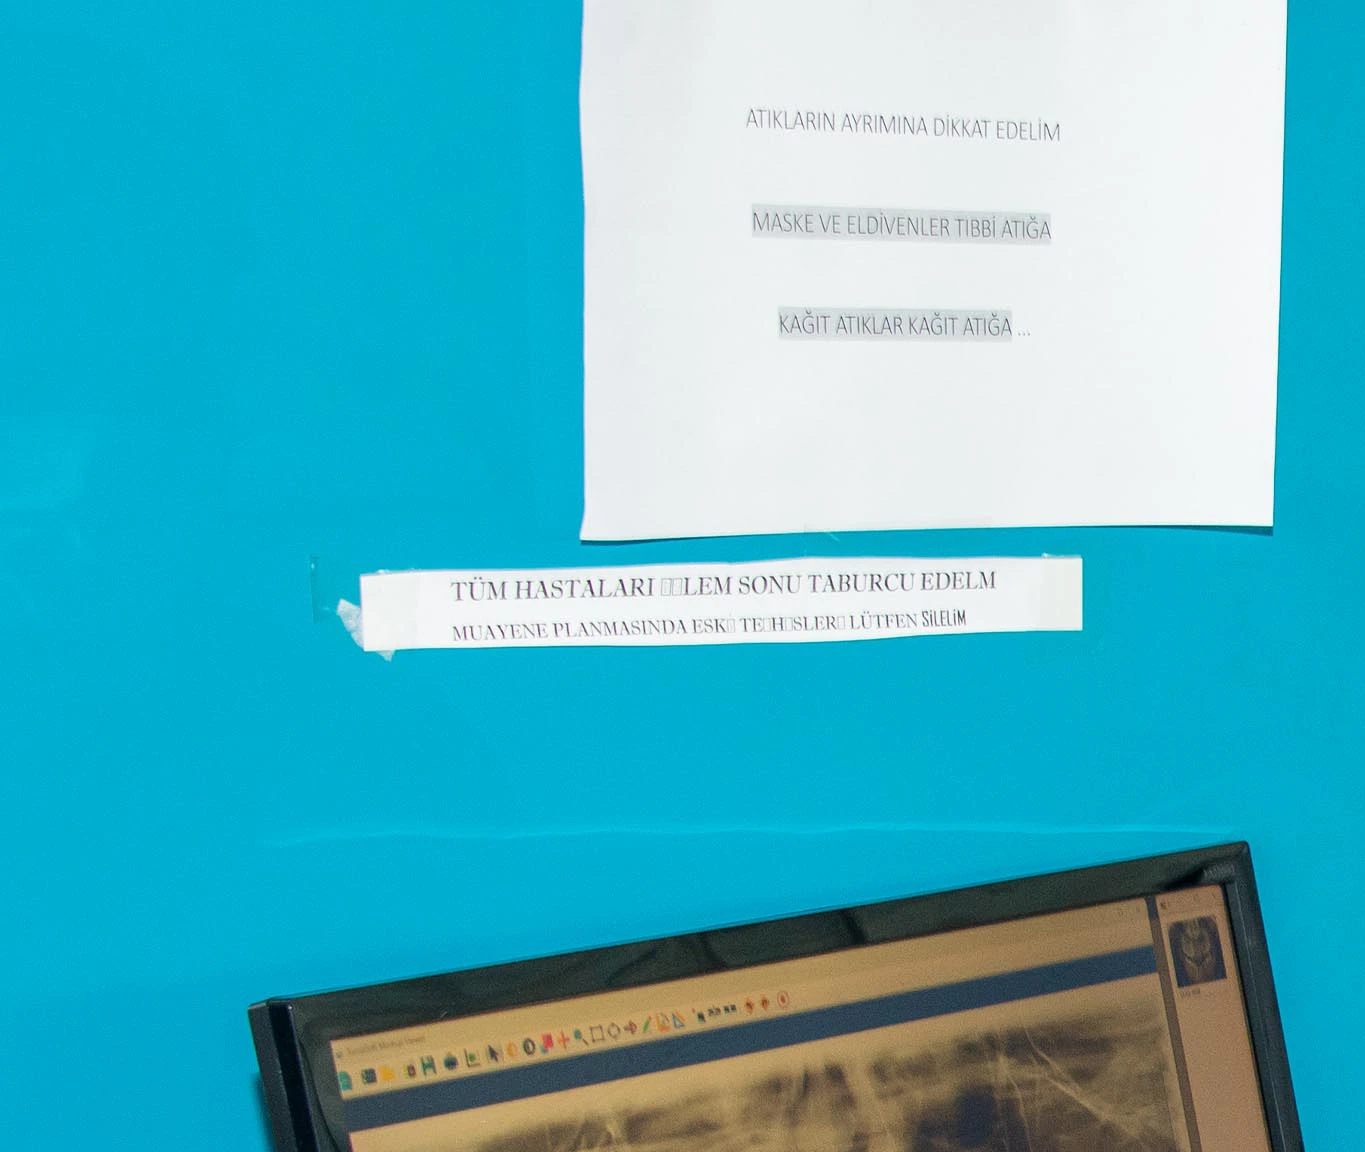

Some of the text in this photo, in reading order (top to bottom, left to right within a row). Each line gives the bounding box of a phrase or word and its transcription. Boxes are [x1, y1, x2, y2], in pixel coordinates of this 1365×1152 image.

[746, 108, 1061, 142] ATIKLARIN AYRIMINA DİKKAT EDELİM
[752, 210, 1052, 240] MASKE VE ELDİVENLER TIBBİ ATIĞA
[778, 310, 831, 334] KAĞIT
[836, 314, 903, 335] ATIKLAR
[908, 312, 958, 335] KAĞIT
[963, 312, 1012, 336] ATIĞA
[450, 570, 997, 601] TÜM HASTALARI LEM SONU TABURCU EDELM
[453, 622, 549, 642] MUAYENE
[553, 618, 687, 639] PLANMASINDA
[692, 615, 735, 634] ESK
[740, 614, 846, 633] TEHSLER
[850, 609, 918, 630] LÜTFEN
